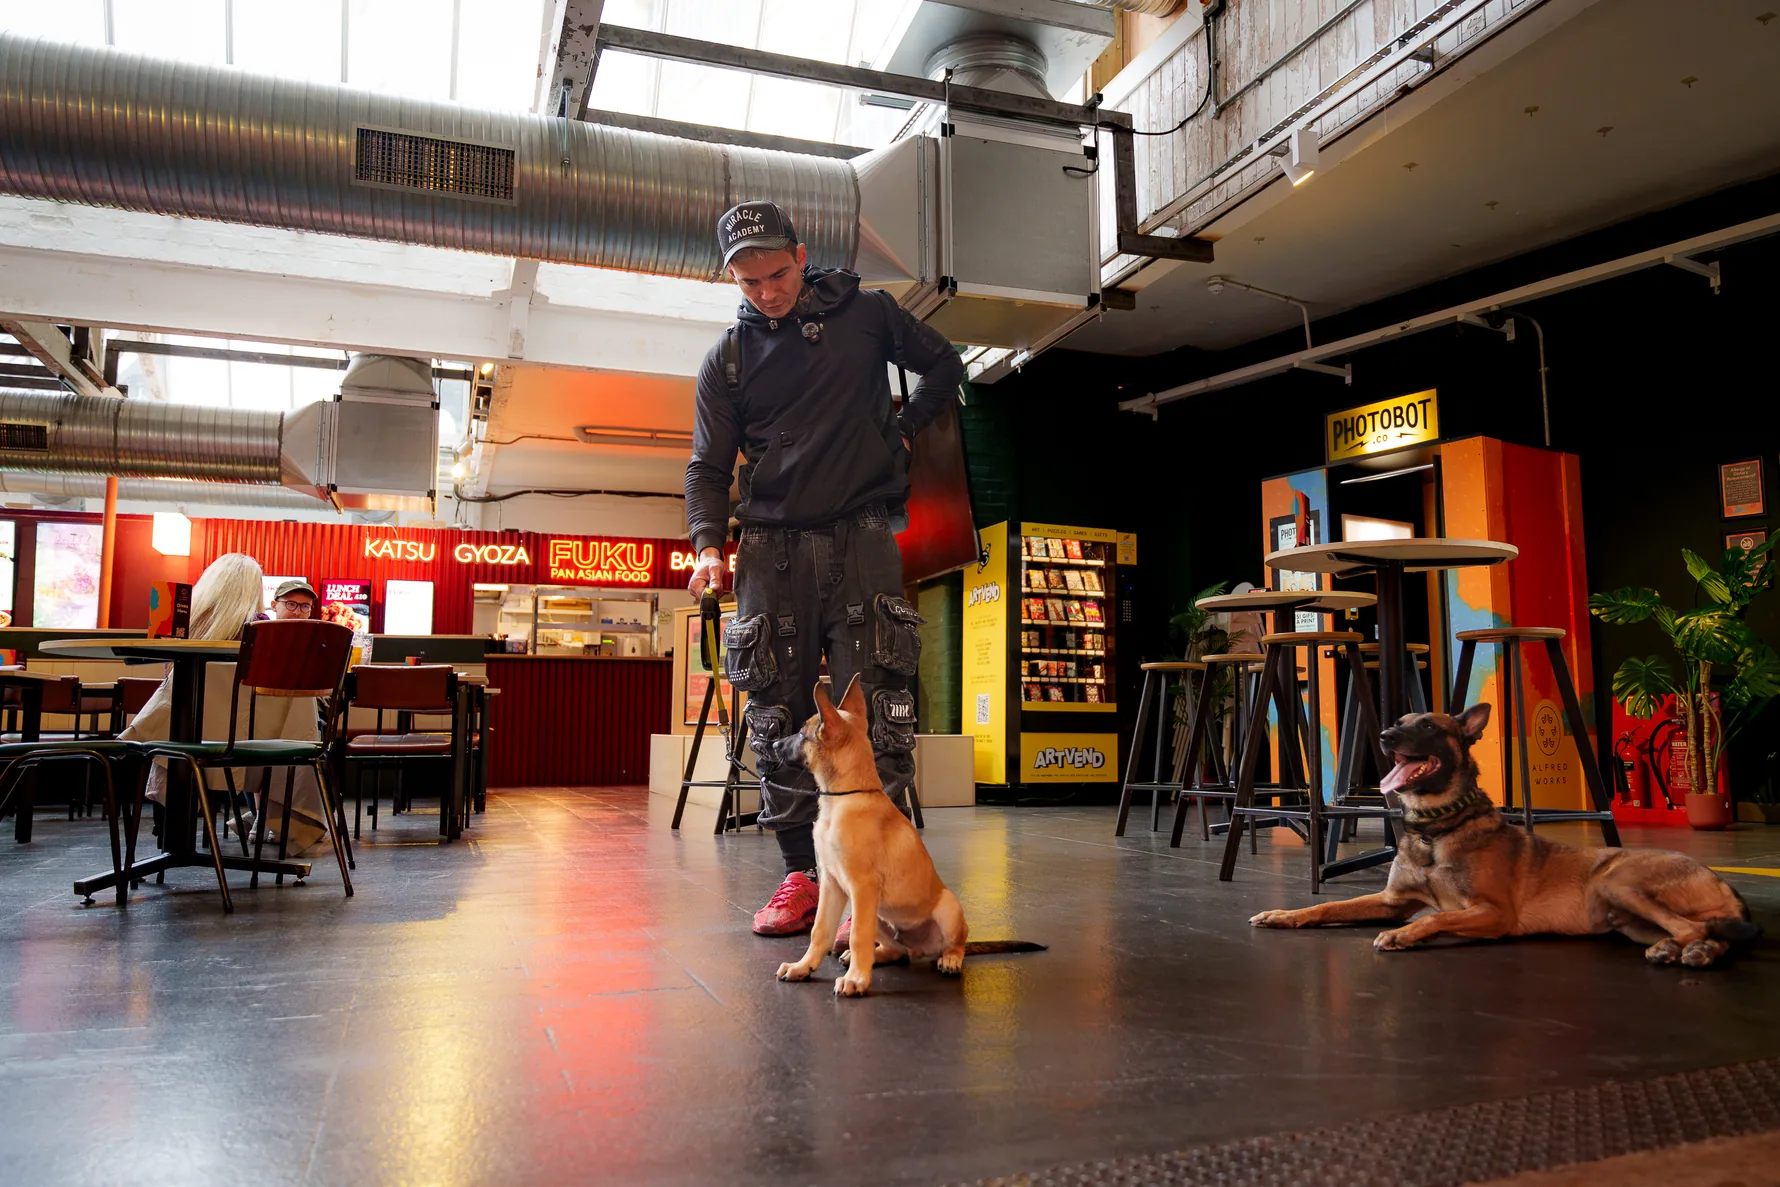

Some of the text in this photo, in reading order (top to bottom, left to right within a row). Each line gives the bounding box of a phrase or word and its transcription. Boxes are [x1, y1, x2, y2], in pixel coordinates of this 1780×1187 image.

[725, 209, 762, 233] MIRACLE
[728, 224, 765, 243] ACADEMY
[1333, 398, 1431, 452] PHOTOBOT
[1280, 527, 1297, 540] PHOT
[365, 538, 435, 561] KATSU
[454, 543, 531, 565] GYOZA
[549, 540, 653, 571] FUKU
[671, 551, 698, 571] BA
[551, 568, 650, 582] PAN ASIAN FOOD
[326, 584, 360, 593] LUNCH
[326, 592, 353, 600] DEAL
[968, 581, 1000, 607] ARTVEND
[1034, 747, 1105, 768] ARTVEND
[1532, 763, 1568, 772] ALFRED
[1534, 777, 1567, 785] WORKS
